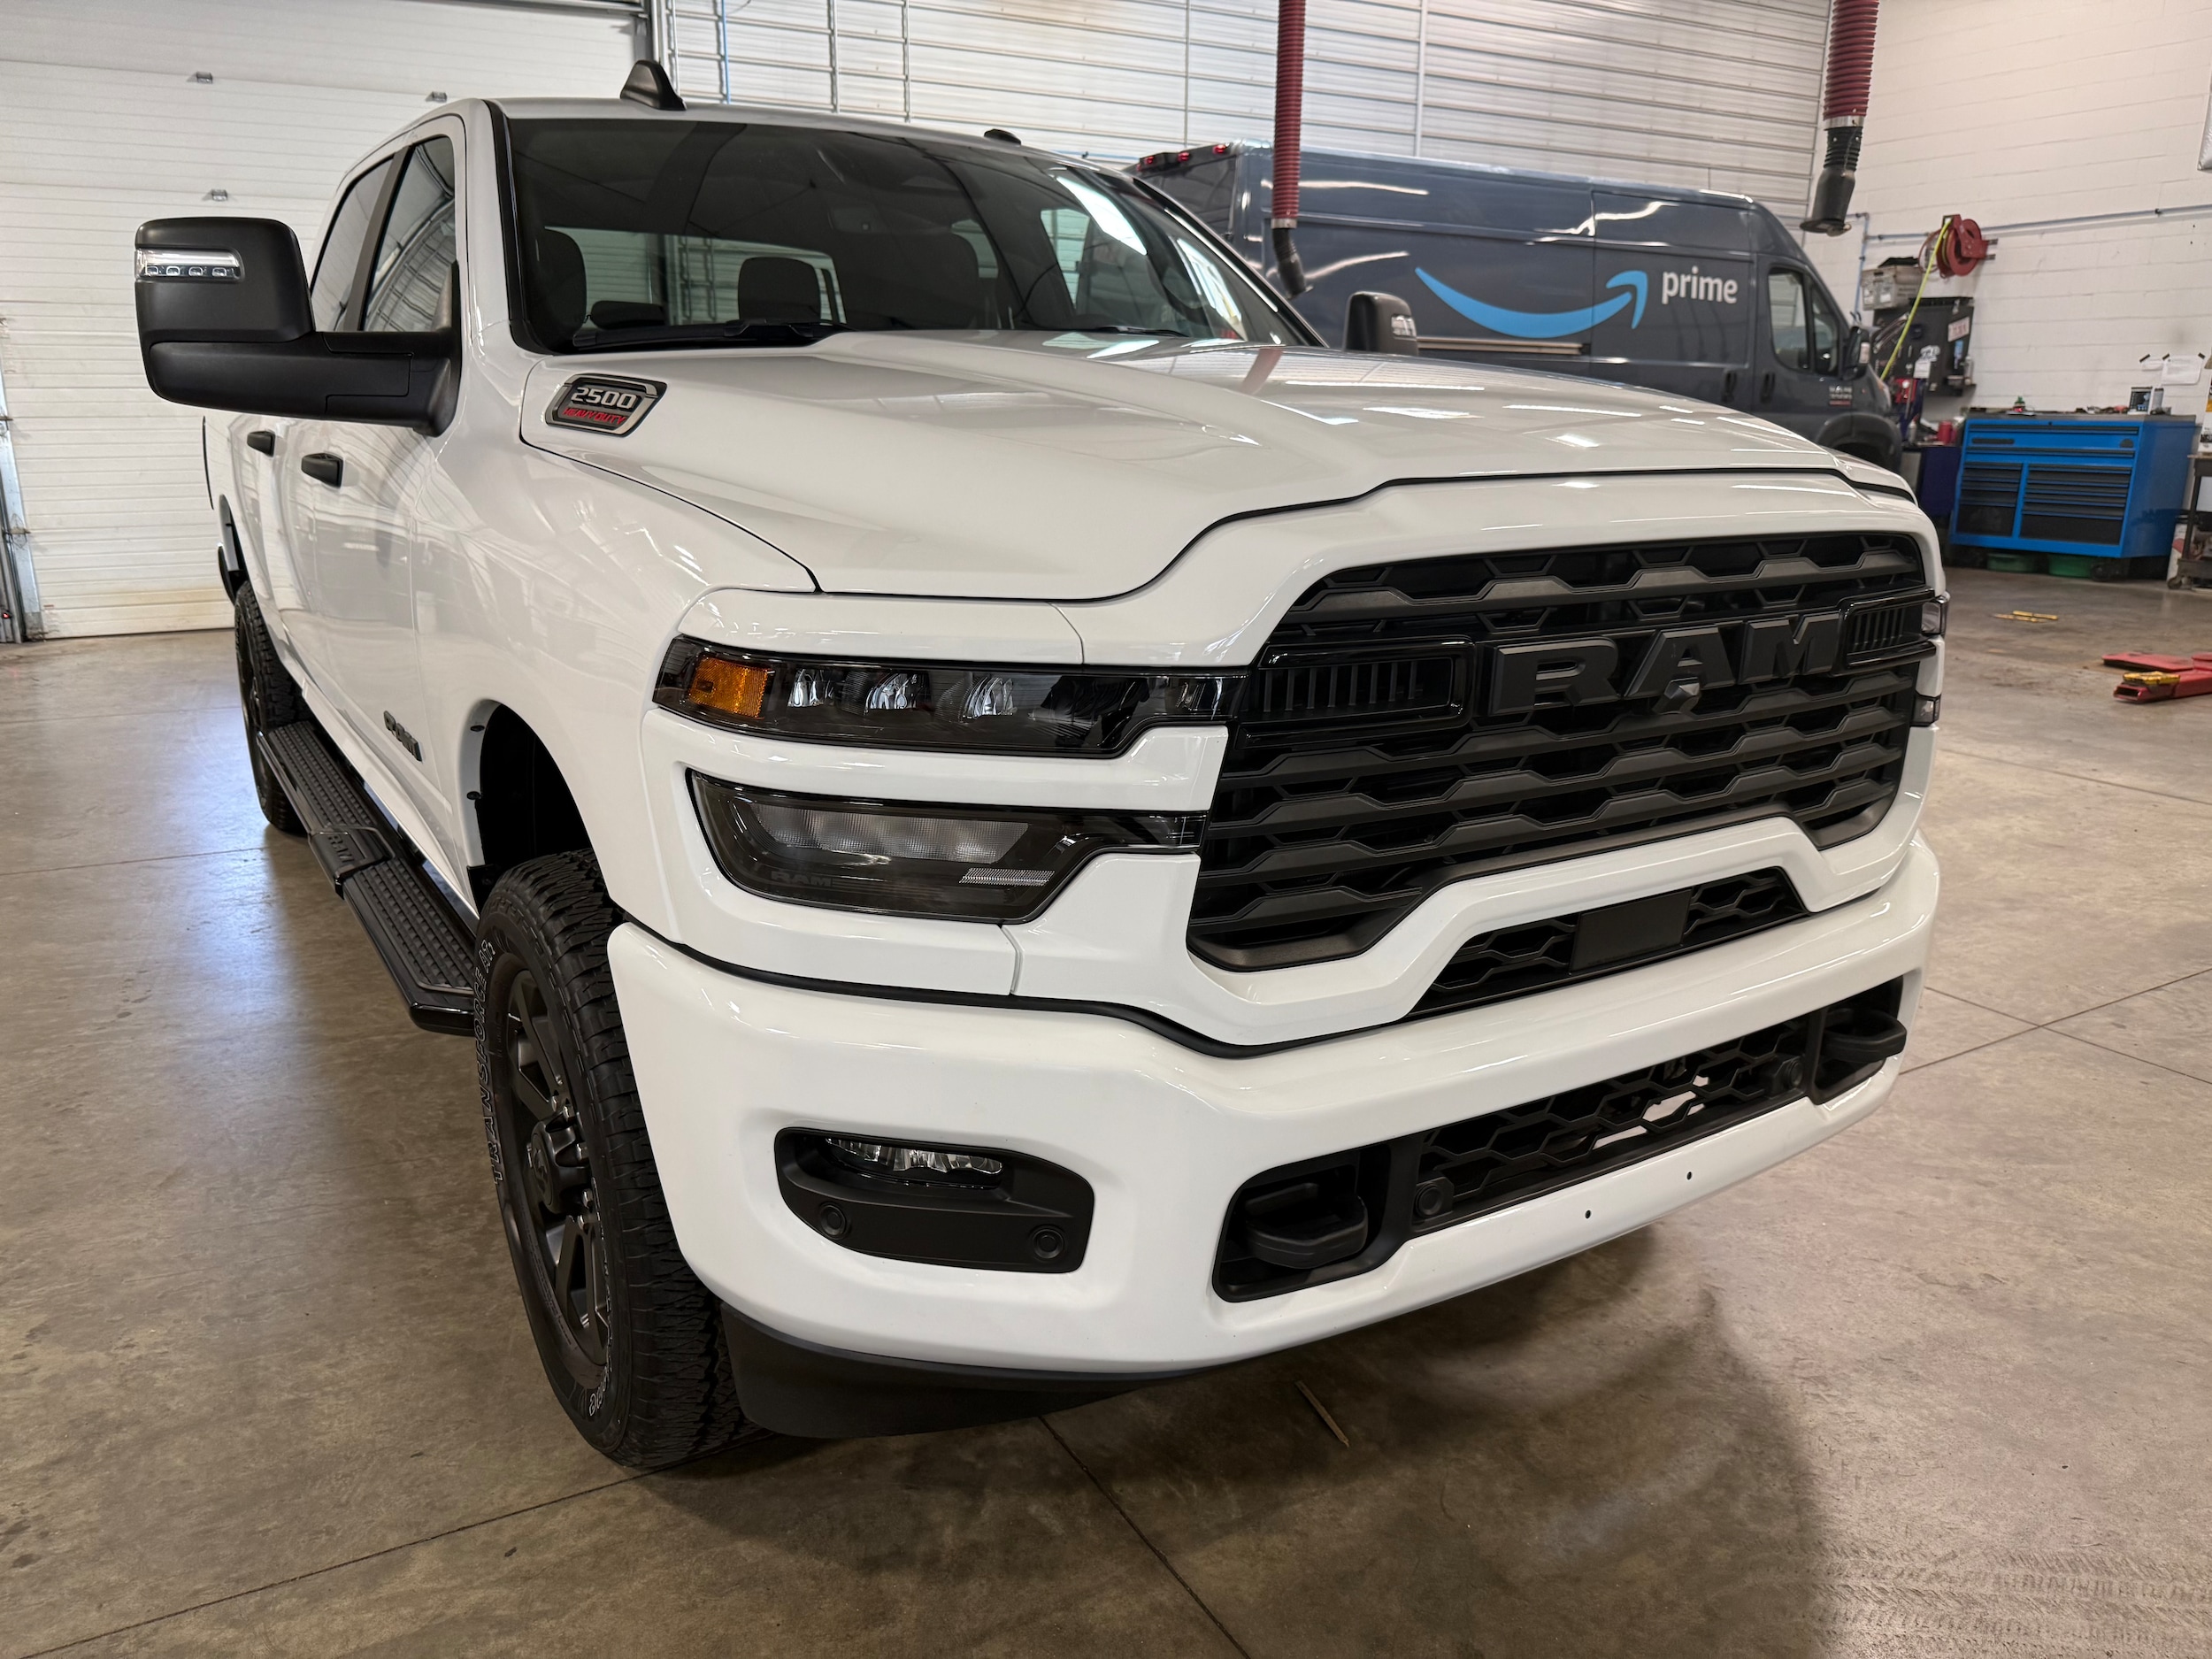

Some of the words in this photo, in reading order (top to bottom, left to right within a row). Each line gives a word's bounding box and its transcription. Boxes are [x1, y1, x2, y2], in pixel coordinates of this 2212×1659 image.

[1662, 265, 1739, 304] prime
[571, 387, 637, 409] 2500
[1487, 611, 1844, 717] RAM
[383, 710, 423, 763] RAM
[772, 870, 832, 887] RAM
[473, 966, 503, 1185] TRANSFORCE
